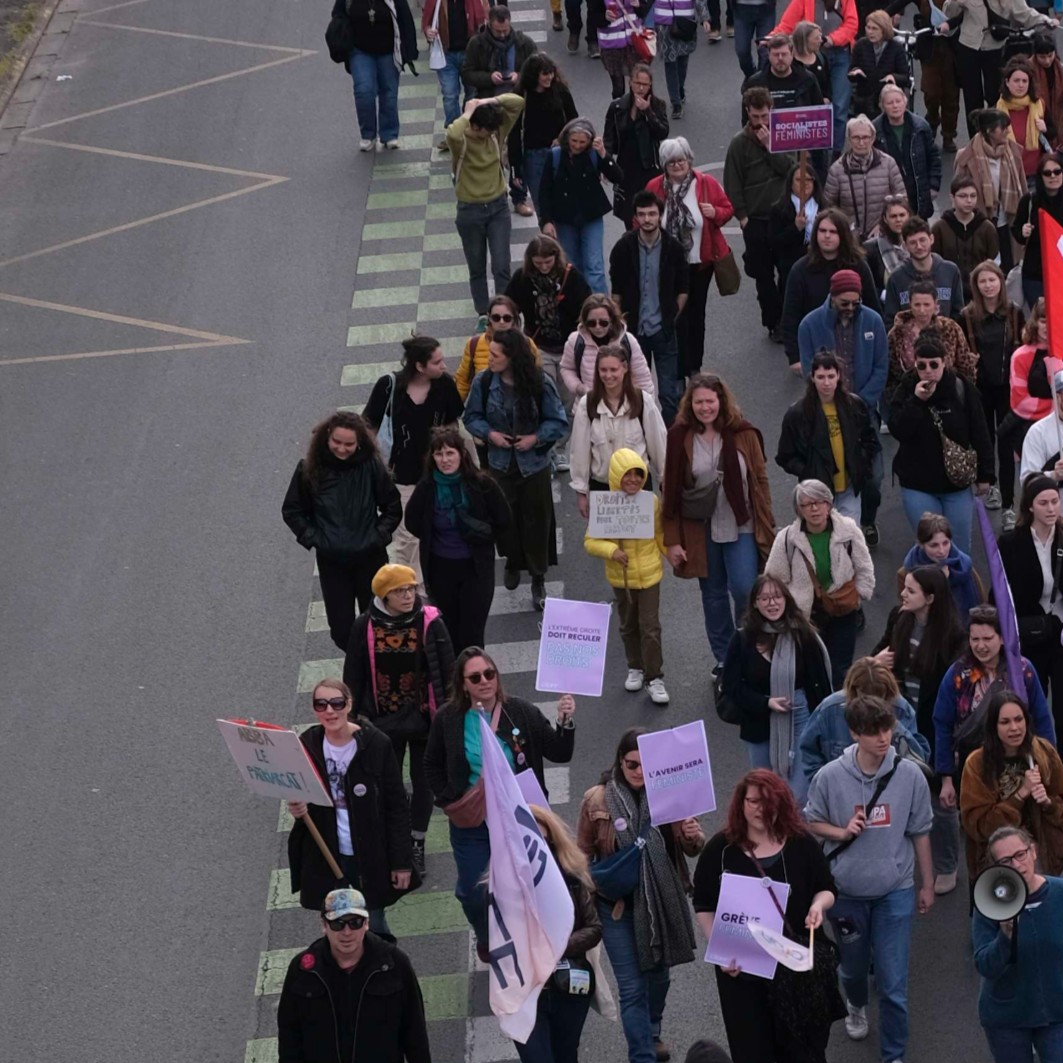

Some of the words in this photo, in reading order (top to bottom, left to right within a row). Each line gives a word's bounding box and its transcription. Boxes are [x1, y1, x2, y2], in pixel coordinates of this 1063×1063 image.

[776, 120, 828, 130] SOCIALISTES
[568, 634, 601, 642] RECULER
[254, 748, 270, 764] LE
[648, 764, 684, 778] L'AVENIR
[684, 758, 703, 769] SERA
